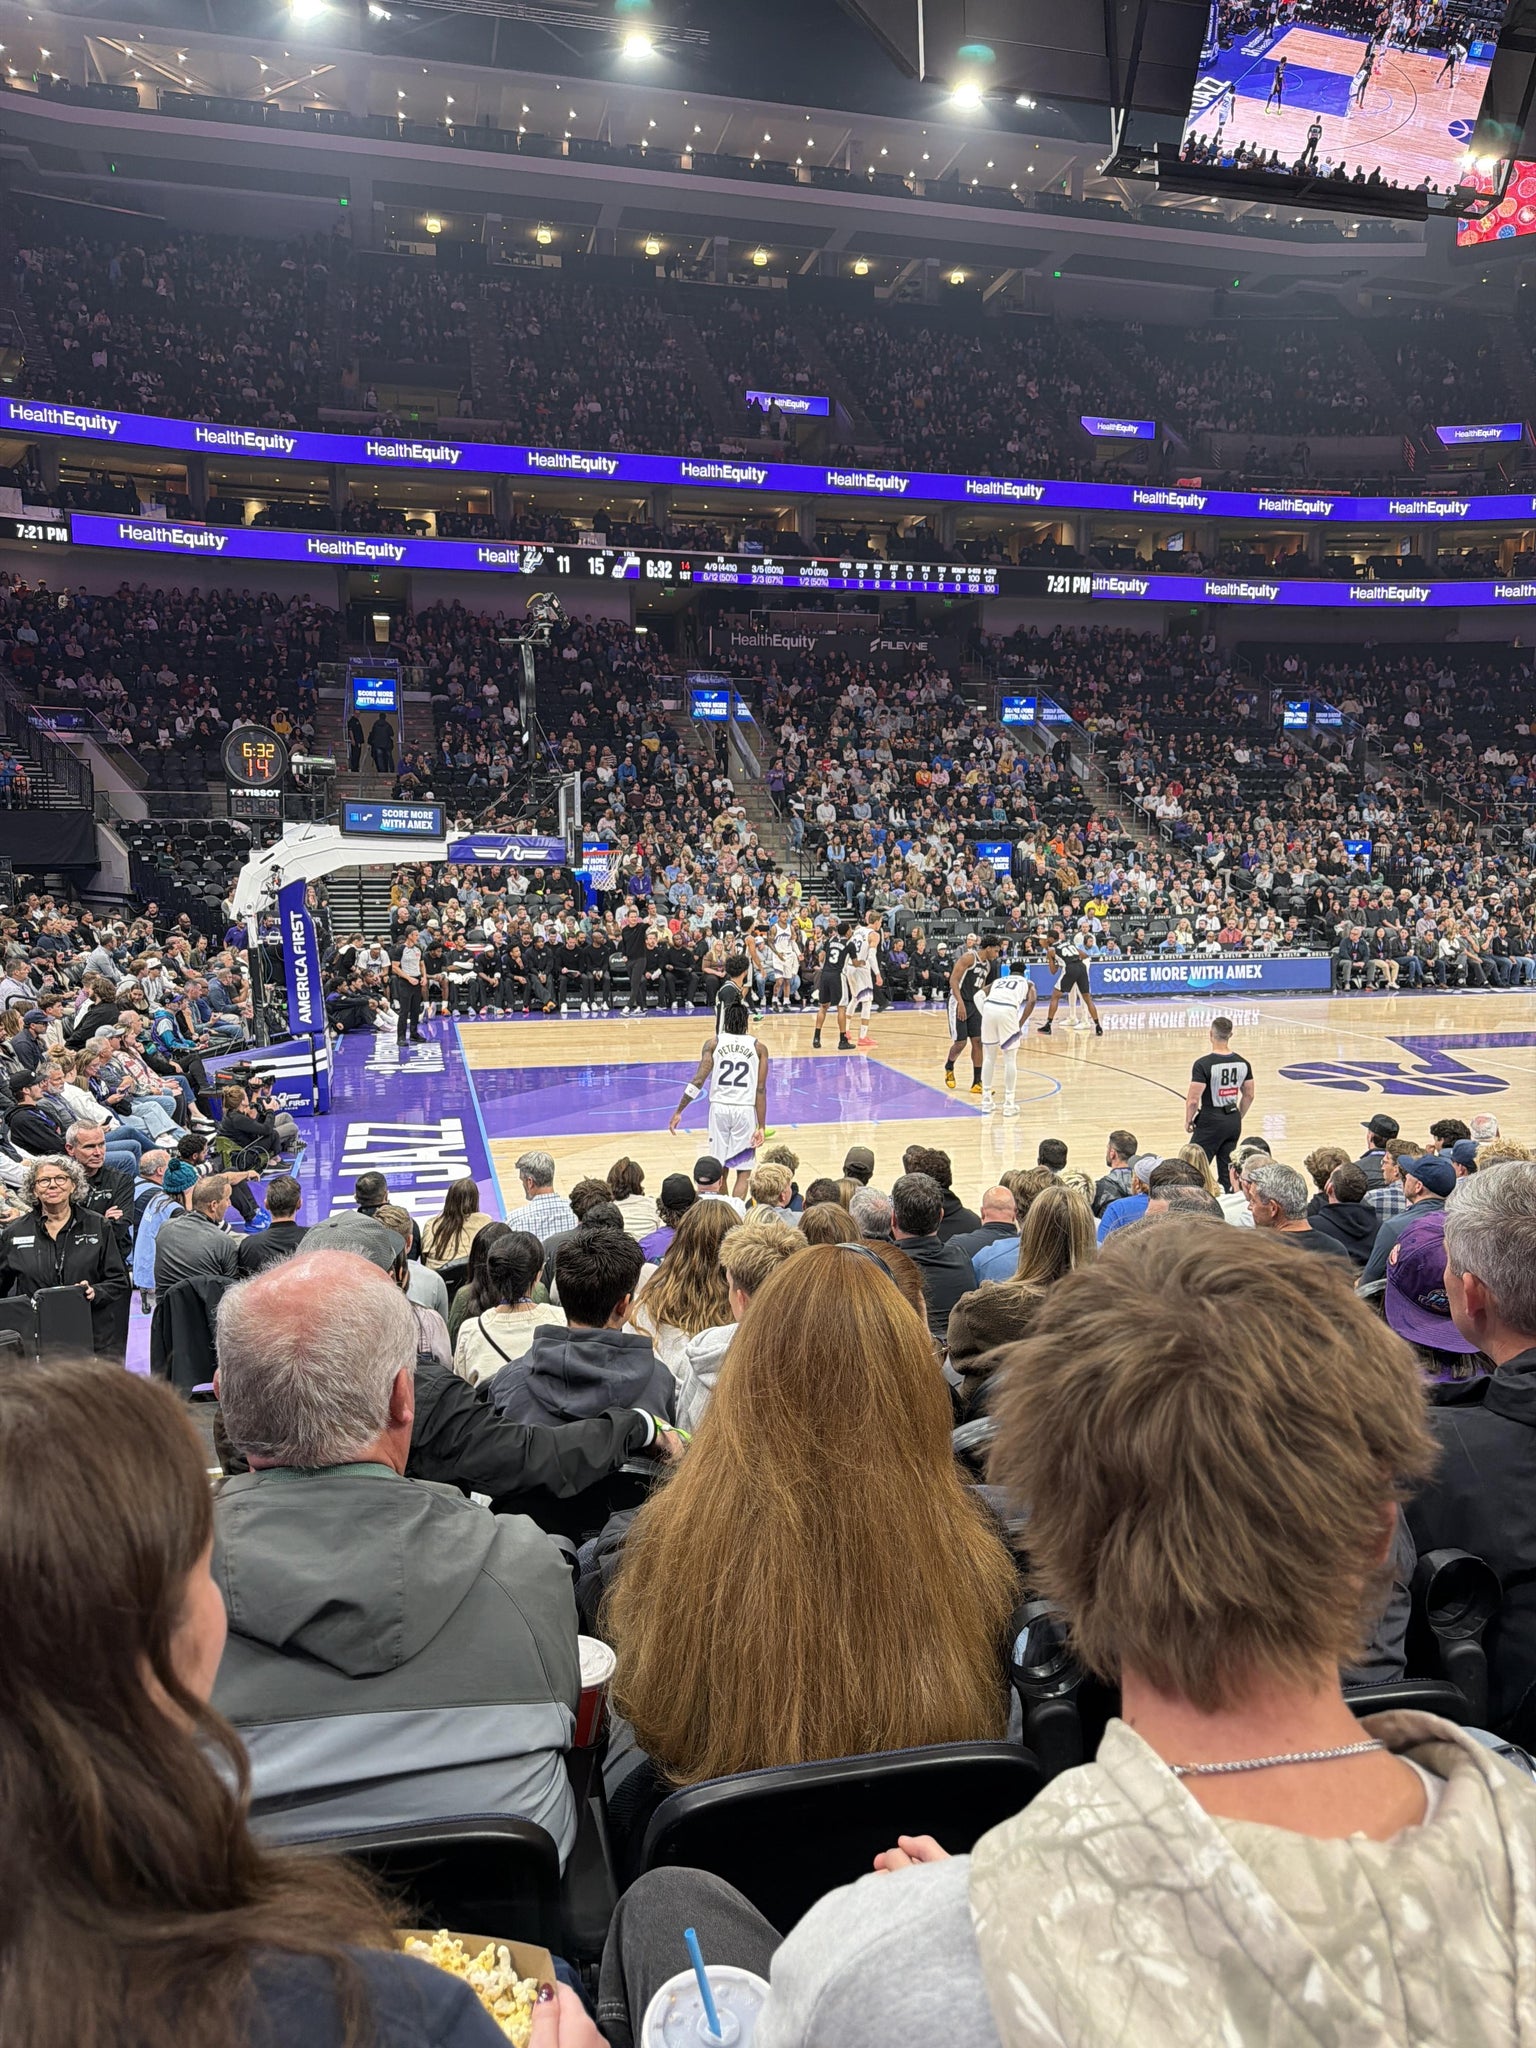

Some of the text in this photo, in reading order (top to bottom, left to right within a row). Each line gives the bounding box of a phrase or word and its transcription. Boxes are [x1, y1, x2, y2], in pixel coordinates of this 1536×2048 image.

[10, 404, 117, 434] HealthEquity
[1096, 422, 1139, 435] HealthEquity
[1455, 428, 1502, 438] HealthEquity
[196, 428, 293, 452] HealthEquity
[367, 442, 460, 464] HealthEquity
[528, 452, 616, 474] HealthEquity
[681, 462, 766, 484] HealthEquity
[827, 471, 907, 493] HealthEquity
[966, 480, 1043, 500] HealthEquity
[1133, 490, 1205, 510] HealthEquity
[1259, 498, 1331, 516] HealthEquity
[1389, 500, 1468, 517] HealthEquity
[16, 524, 68, 542] 7:21 PM
[120, 523, 226, 551] HealthEquity
[308, 539, 405, 561] HealthEquity
[557, 555, 571, 573] 11
[588, 557, 605, 575] 15
[646, 560, 673, 579] 6:32
[680, 561, 691, 570] 14
[704, 562, 718, 572] 4/9
[751, 565, 764, 574] 3/5
[800, 567, 814, 576] 0/0
[842, 569, 848, 578] 0
[858, 569, 865, 578] 3
[874, 570, 881, 579] 3
[890, 571, 897, 580] 3
[906, 572, 913, 580] 0
[922, 573, 929, 581] 0
[938, 573, 945, 581] 2
[955, 574, 962, 582] 0
[968, 575, 980, 583] 100
[985, 575, 995, 583] 121
[679, 571, 691, 580] 1ST
[751, 575, 765, 584] 2/3
[799, 577, 810, 586] 1/2
[858, 579, 865, 588] 5
[890, 581, 896, 589] 4
[938, 583, 944, 591] 0
[955, 584, 961, 592] 0
[968, 584, 980, 593] 123
[984, 585, 996, 593] 100
[1048, 575, 1091, 593] 7:21 PM
[1205, 582, 1277, 600] HealthEquity
[1350, 586, 1429, 602] HealthEquity
[1494, 584, 1536, 598] Health
[731, 633, 816, 650] HealthEquity
[881, 640, 928, 650] FILEVNE
[242, 742, 275, 758] 6:32
[247, 758, 269, 779] 14
[243, 789, 281, 797] TISSOT
[381, 809, 434, 820] SCORE MORE
[382, 819, 433, 830] WITH AMEX
[828, 949, 840, 964] 3
[1061, 944, 1080, 957] 40
[290, 910, 313, 1024] AMERICA FIRST
[1103, 964, 1263, 983] SCORE MORE WITH AMEX
[994, 980, 1018, 990] 20
[717, 1043, 754, 1060] PETERSON
[718, 1059, 750, 1088] 22
[1221, 1067, 1238, 1086] 84
[289, 1099, 311, 1107] FIRST
[338, 1118, 472, 1184] JAZZ
